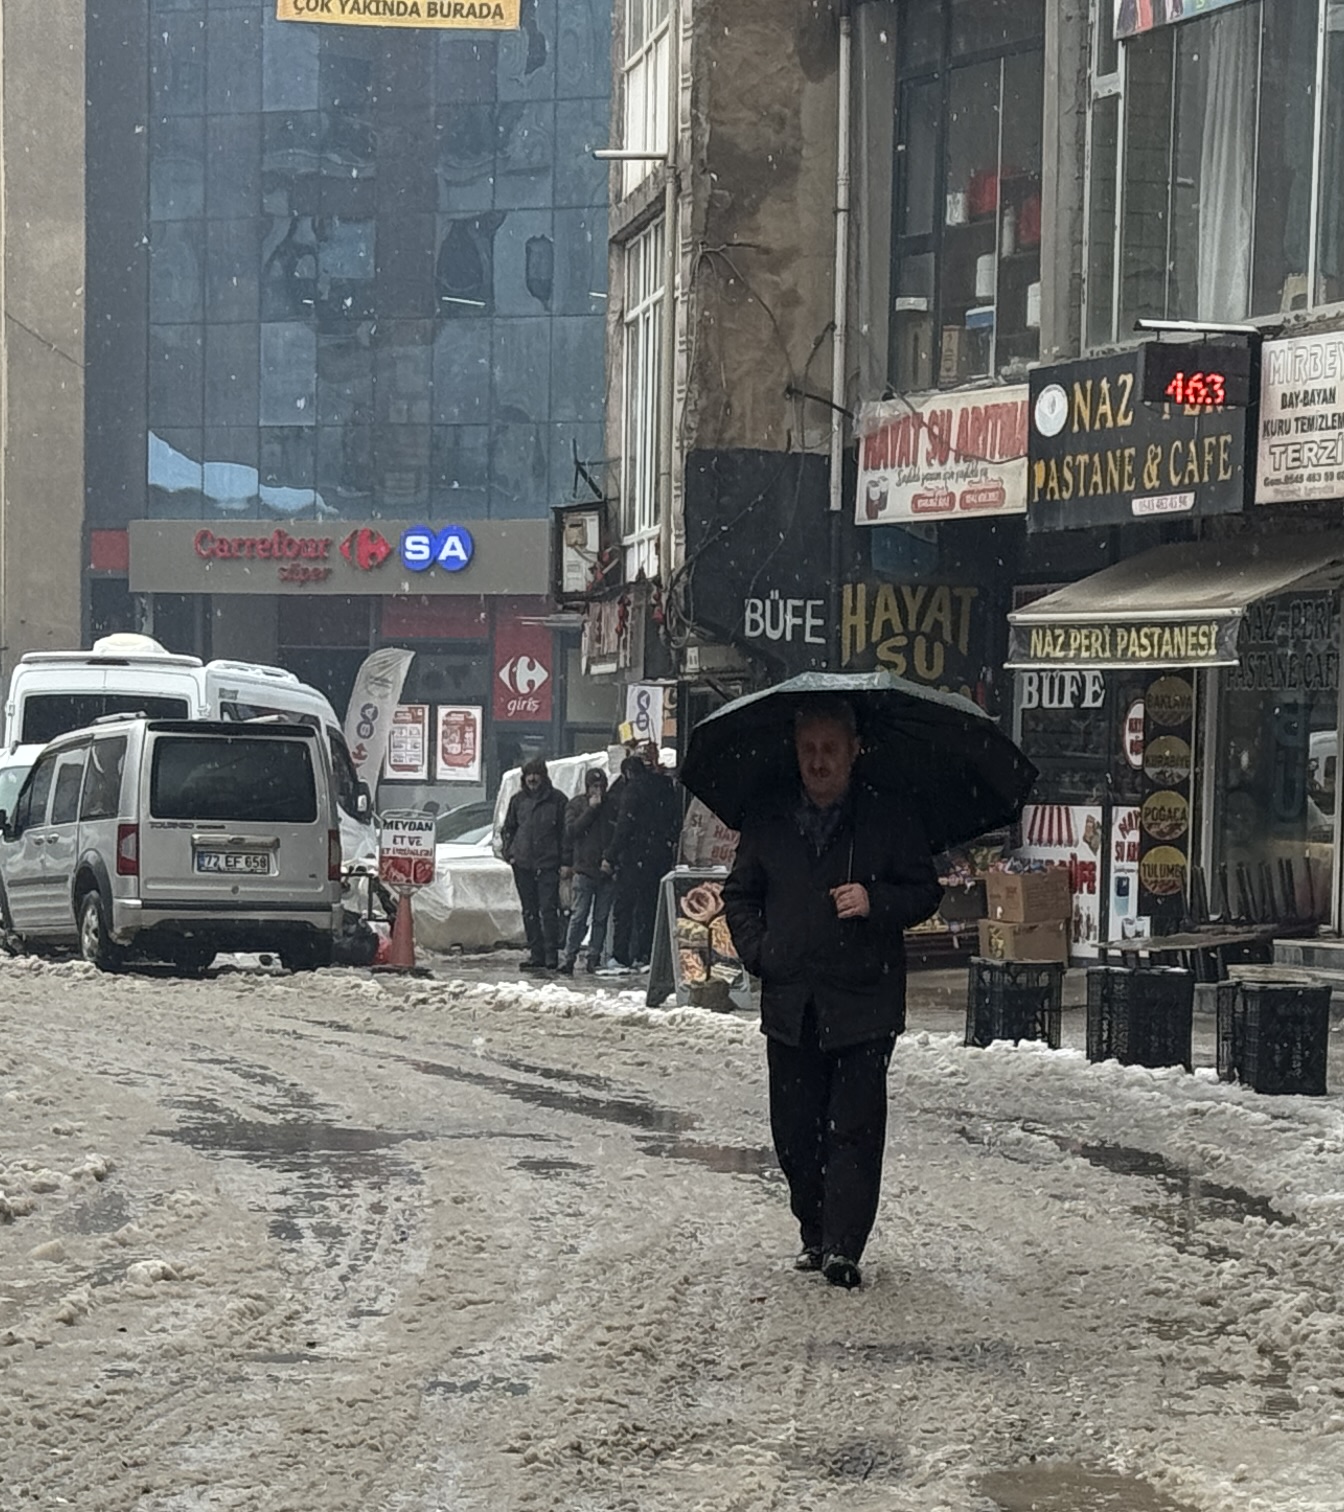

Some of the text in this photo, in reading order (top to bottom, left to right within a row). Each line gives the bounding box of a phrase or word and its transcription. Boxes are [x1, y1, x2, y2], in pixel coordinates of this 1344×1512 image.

[294, 0, 505, 20] ÇOK YAKINDA BURADA
[1072, 372, 1134, 434] NAZ
[1280, 386, 1337, 410] BAY-BAYAN
[1261, 417, 1291, 438] KURU
[1032, 433, 1233, 503] PASTANE & CAFE
[193, 528, 468, 561] Carrefour SA
[277, 562, 333, 586] süper
[744, 582, 979, 668] BÜFE HAYAT
[1030, 621, 1219, 659] NAZ PERİ PASTANESİ
[876, 634, 945, 681] SU
[507, 697, 540, 717] giriş
[382, 819, 433, 832] MEYDAN
[392, 834, 406, 846] ET
[224, 855, 243, 868] EF
